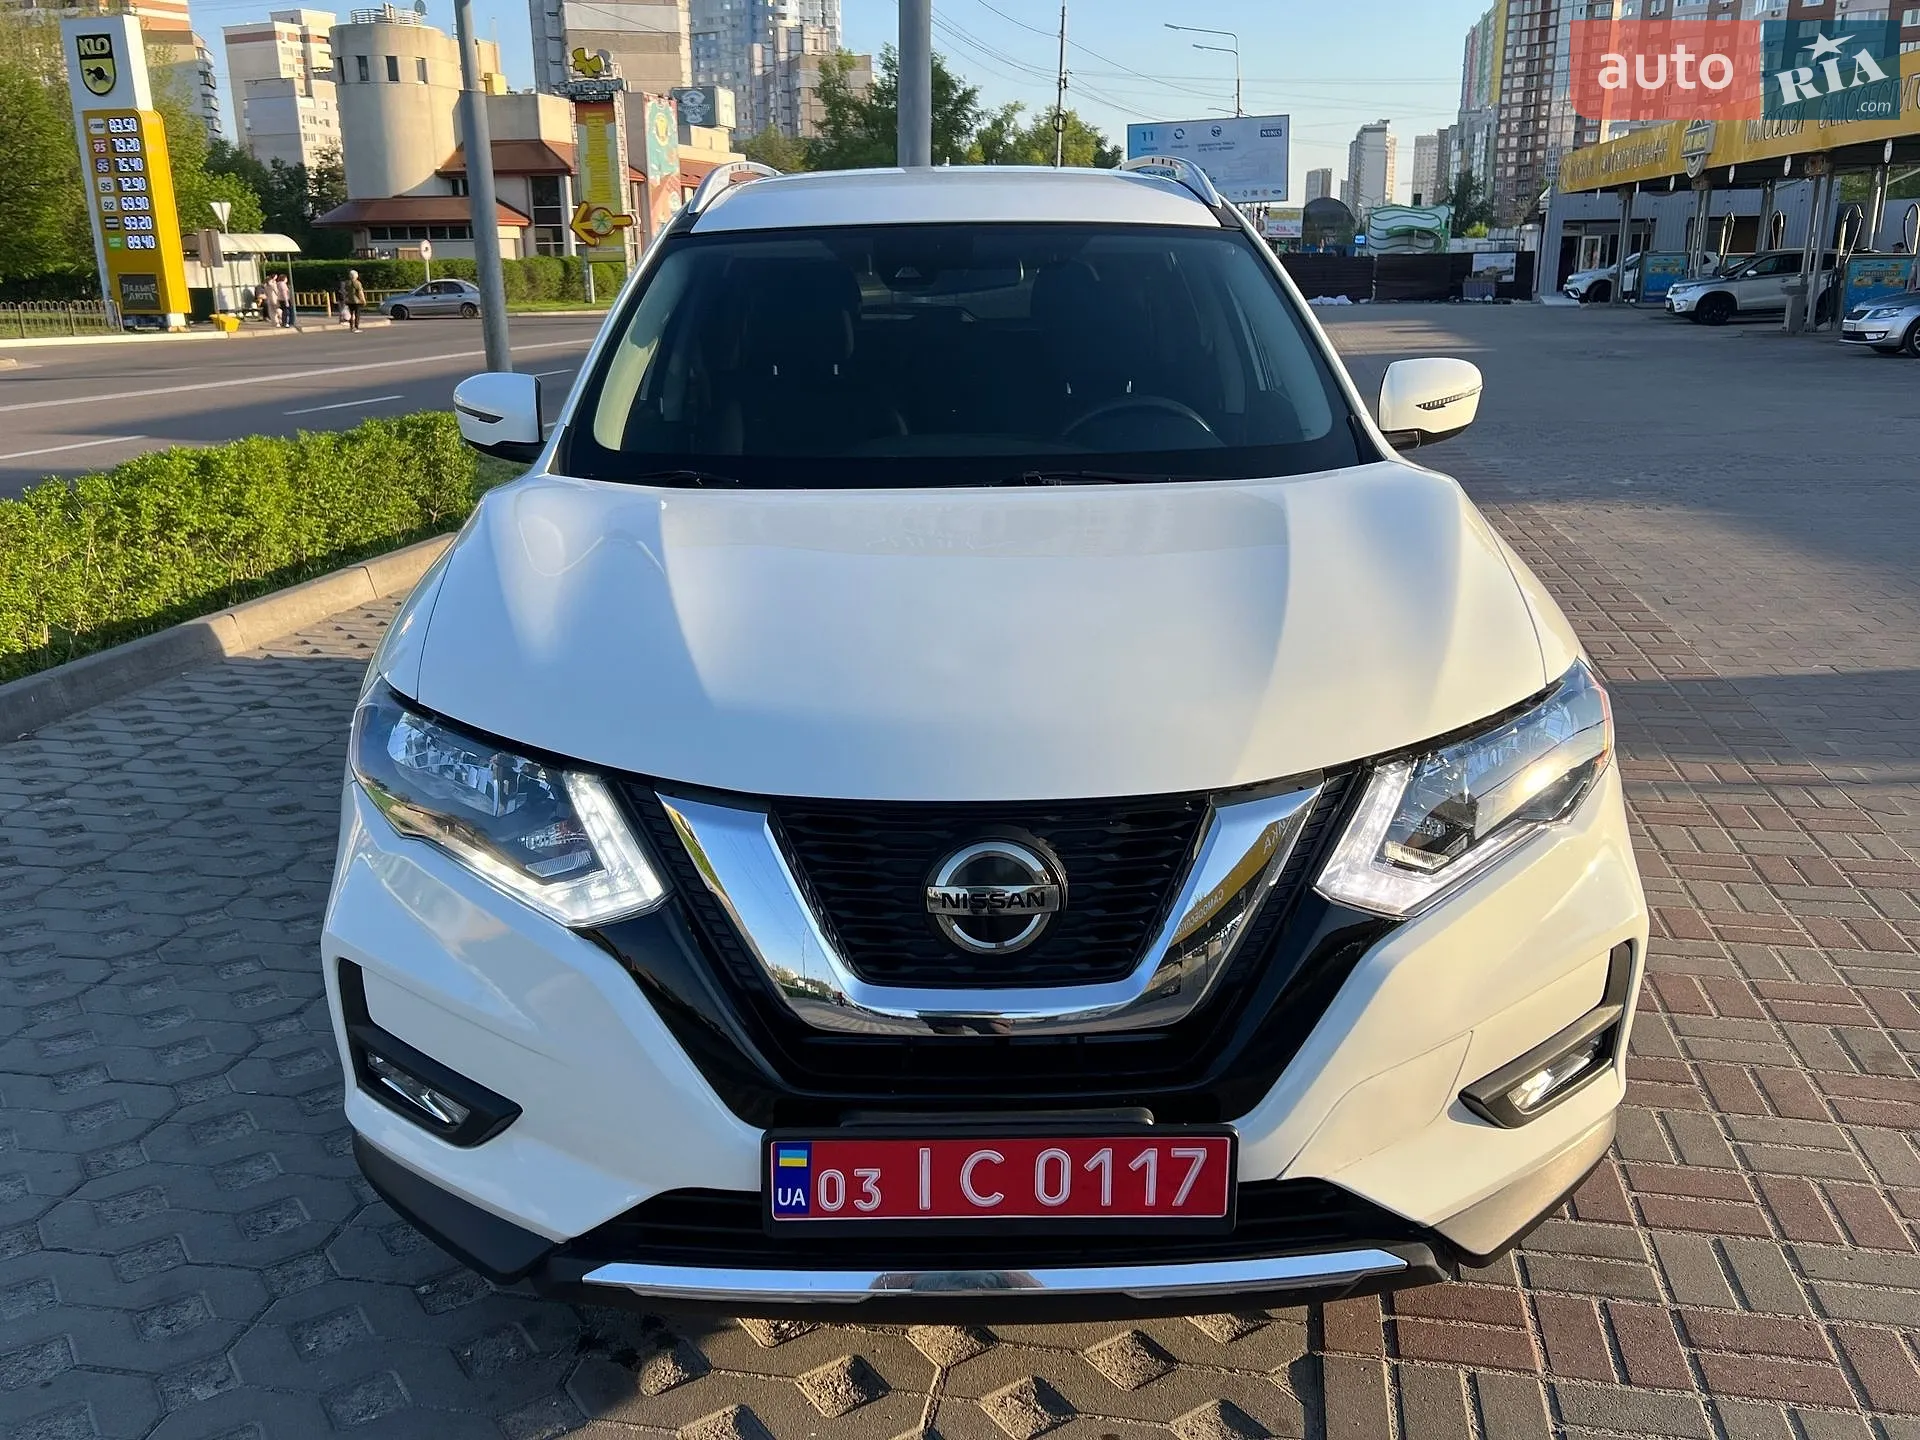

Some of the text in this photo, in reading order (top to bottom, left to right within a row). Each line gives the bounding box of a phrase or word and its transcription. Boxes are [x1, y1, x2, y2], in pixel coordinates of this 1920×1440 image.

[79, 37, 110, 55] KLO
[93, 143, 106, 152] 95
[97, 163, 109, 172] 95
[101, 182, 111, 191] 95
[103, 197, 149, 210] 92 69.90
[941, 891, 1045, 910] NISSAN
[818, 1168, 882, 1212] 03
[1034, 1147, 1207, 1207] 0117
[778, 1187, 806, 1206] UA
